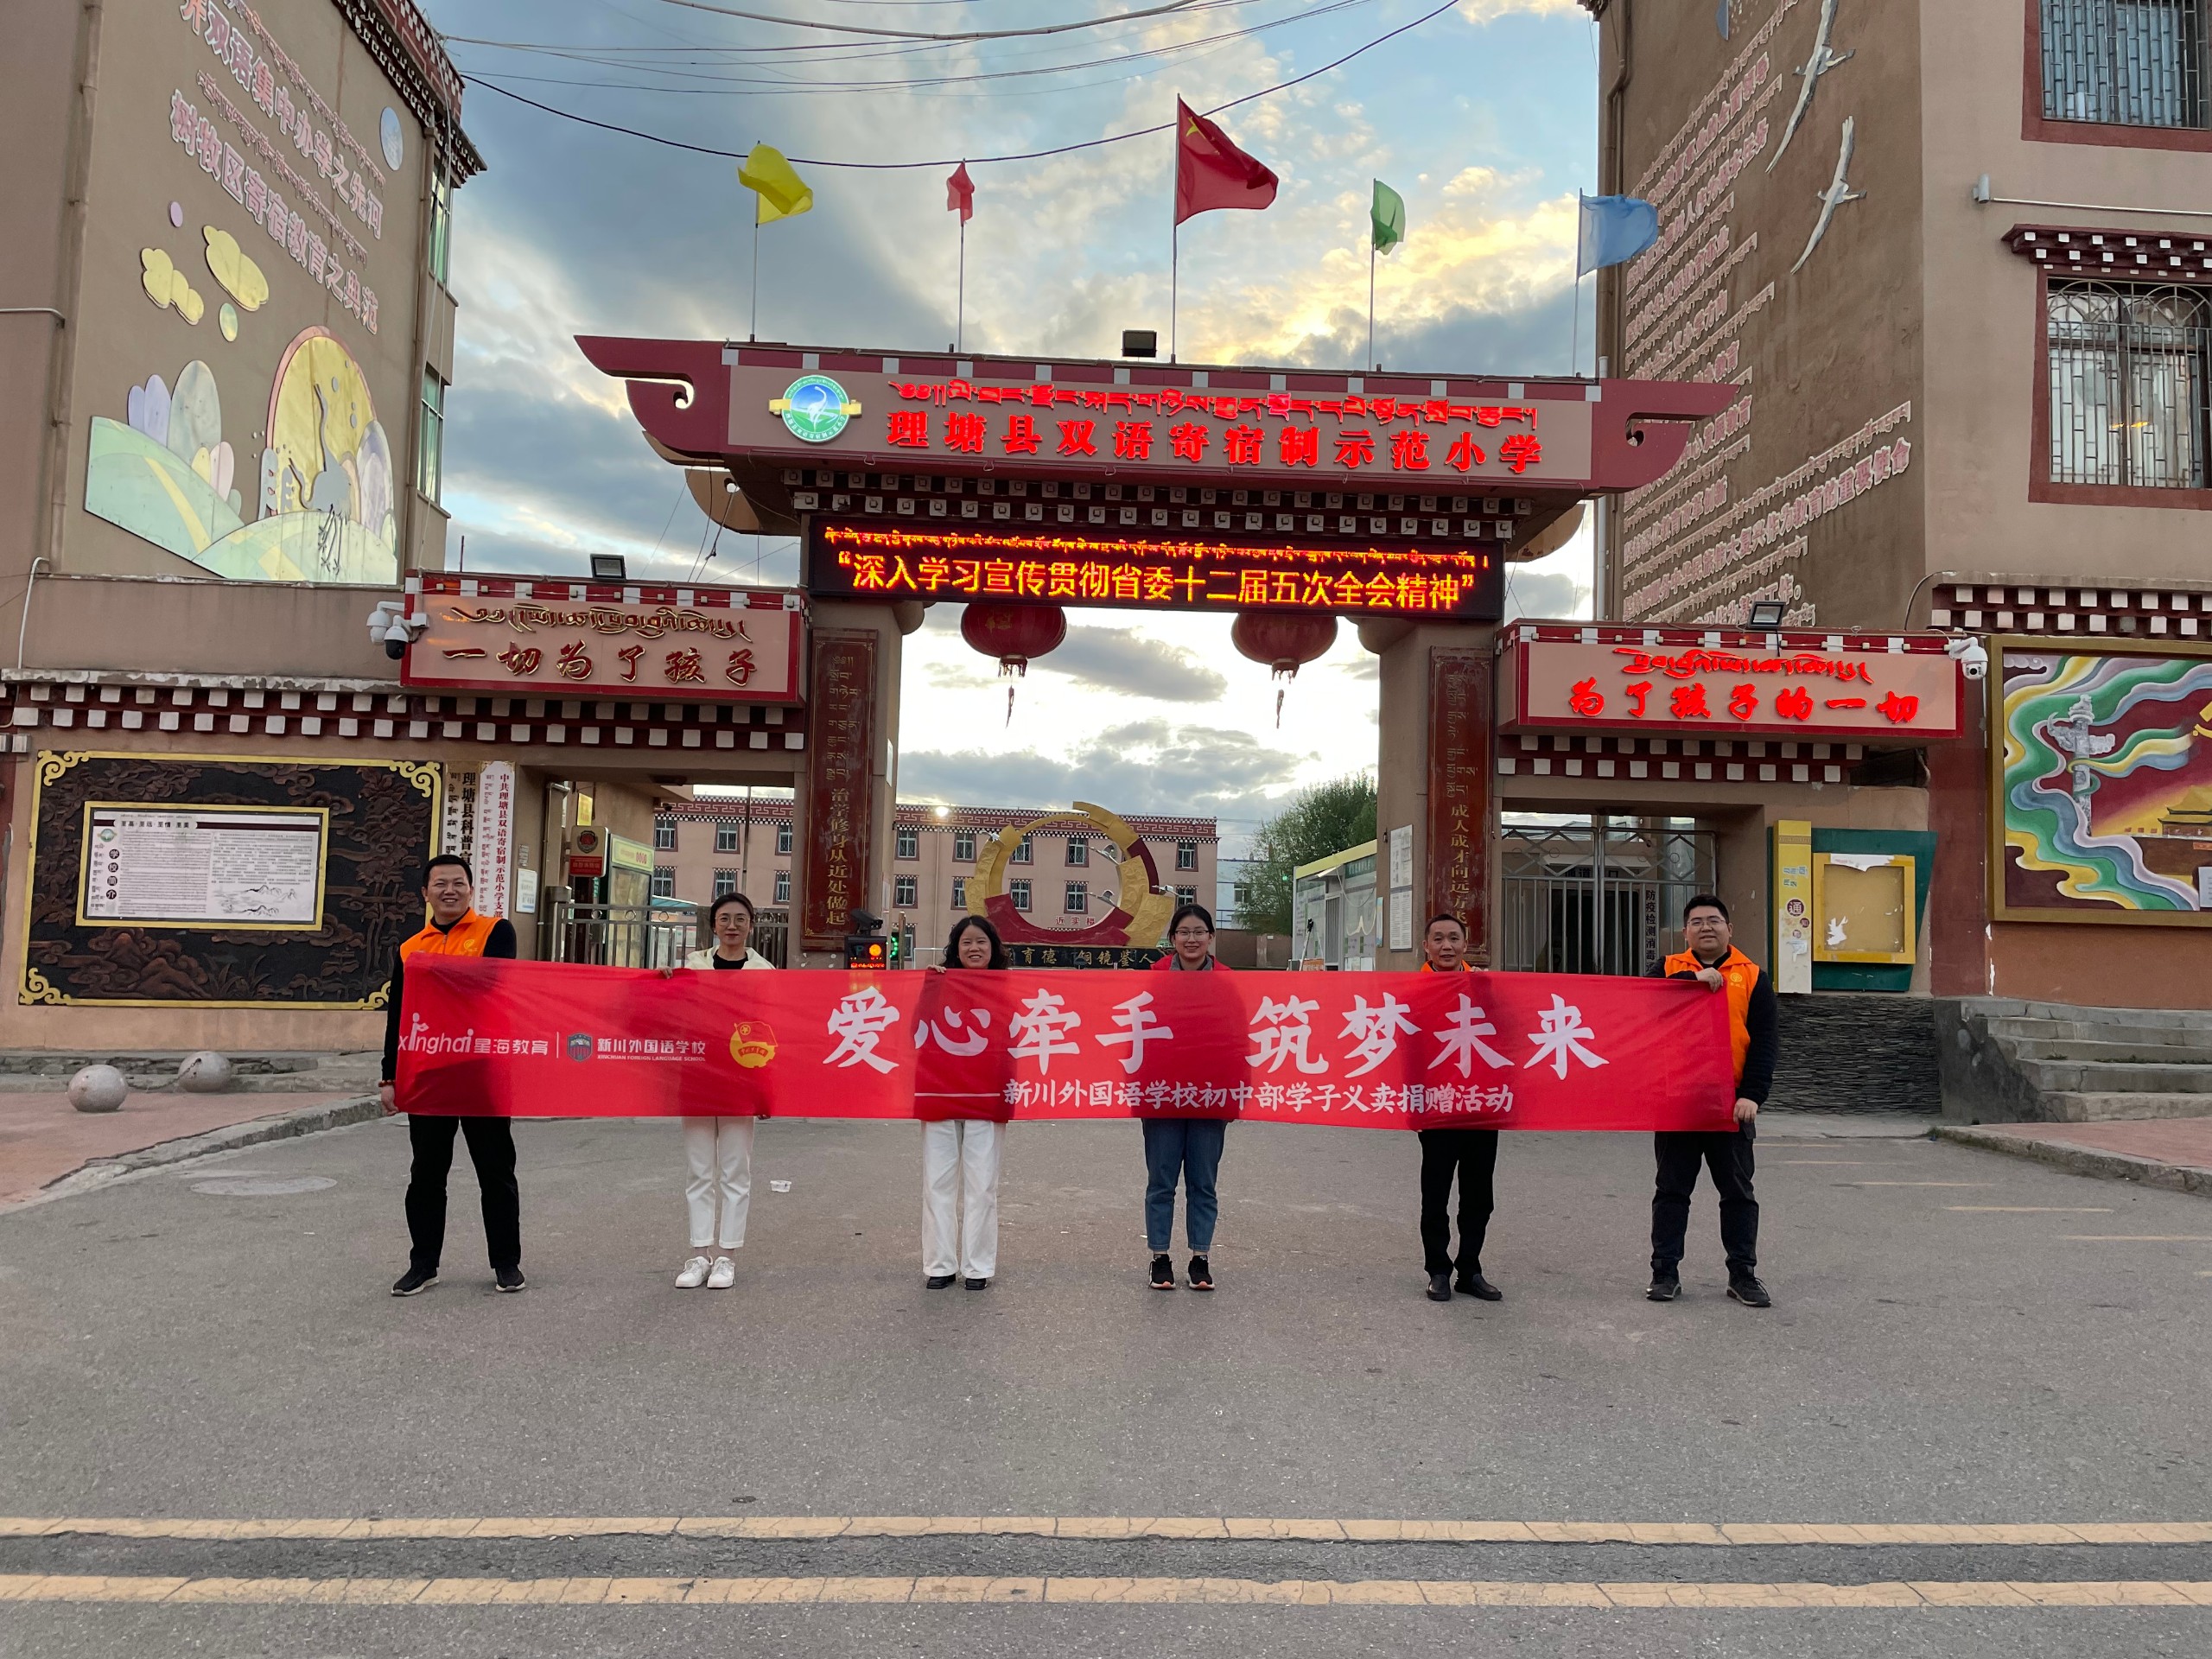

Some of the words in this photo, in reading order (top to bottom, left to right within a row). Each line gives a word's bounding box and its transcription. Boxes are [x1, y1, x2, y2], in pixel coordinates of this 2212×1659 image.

[170, 89, 378, 334] 树牧区寄宿教育之典范
[886, 410, 1542, 474] 理塘县双语寄宿制示范小学
[1624, 474, 1728, 567] 坚持深化教育改革创新
[839, 550, 1474, 611] “深入学习宣传贯彻省委十二届五次全会精神”
[442, 639, 757, 687] 一切为了孩子
[1569, 677, 1920, 724] 为了孩子的一切
[826, 787, 850, 925] 治学修身从近处做起
[1450, 804, 1471, 940] 成人成才向远方飞
[397, 1012, 474, 1055] xinghai
[474, 1037, 549, 1056] 星海教育
[597, 1038, 706, 1055] 新川外国语学校
[823, 985, 1173, 1075] 爱心牵手
[1245, 992, 1609, 1081] 筑梦未来
[1002, 1077, 1514, 1116] 新川外国语学校初中部学子义卖捐赠活动
